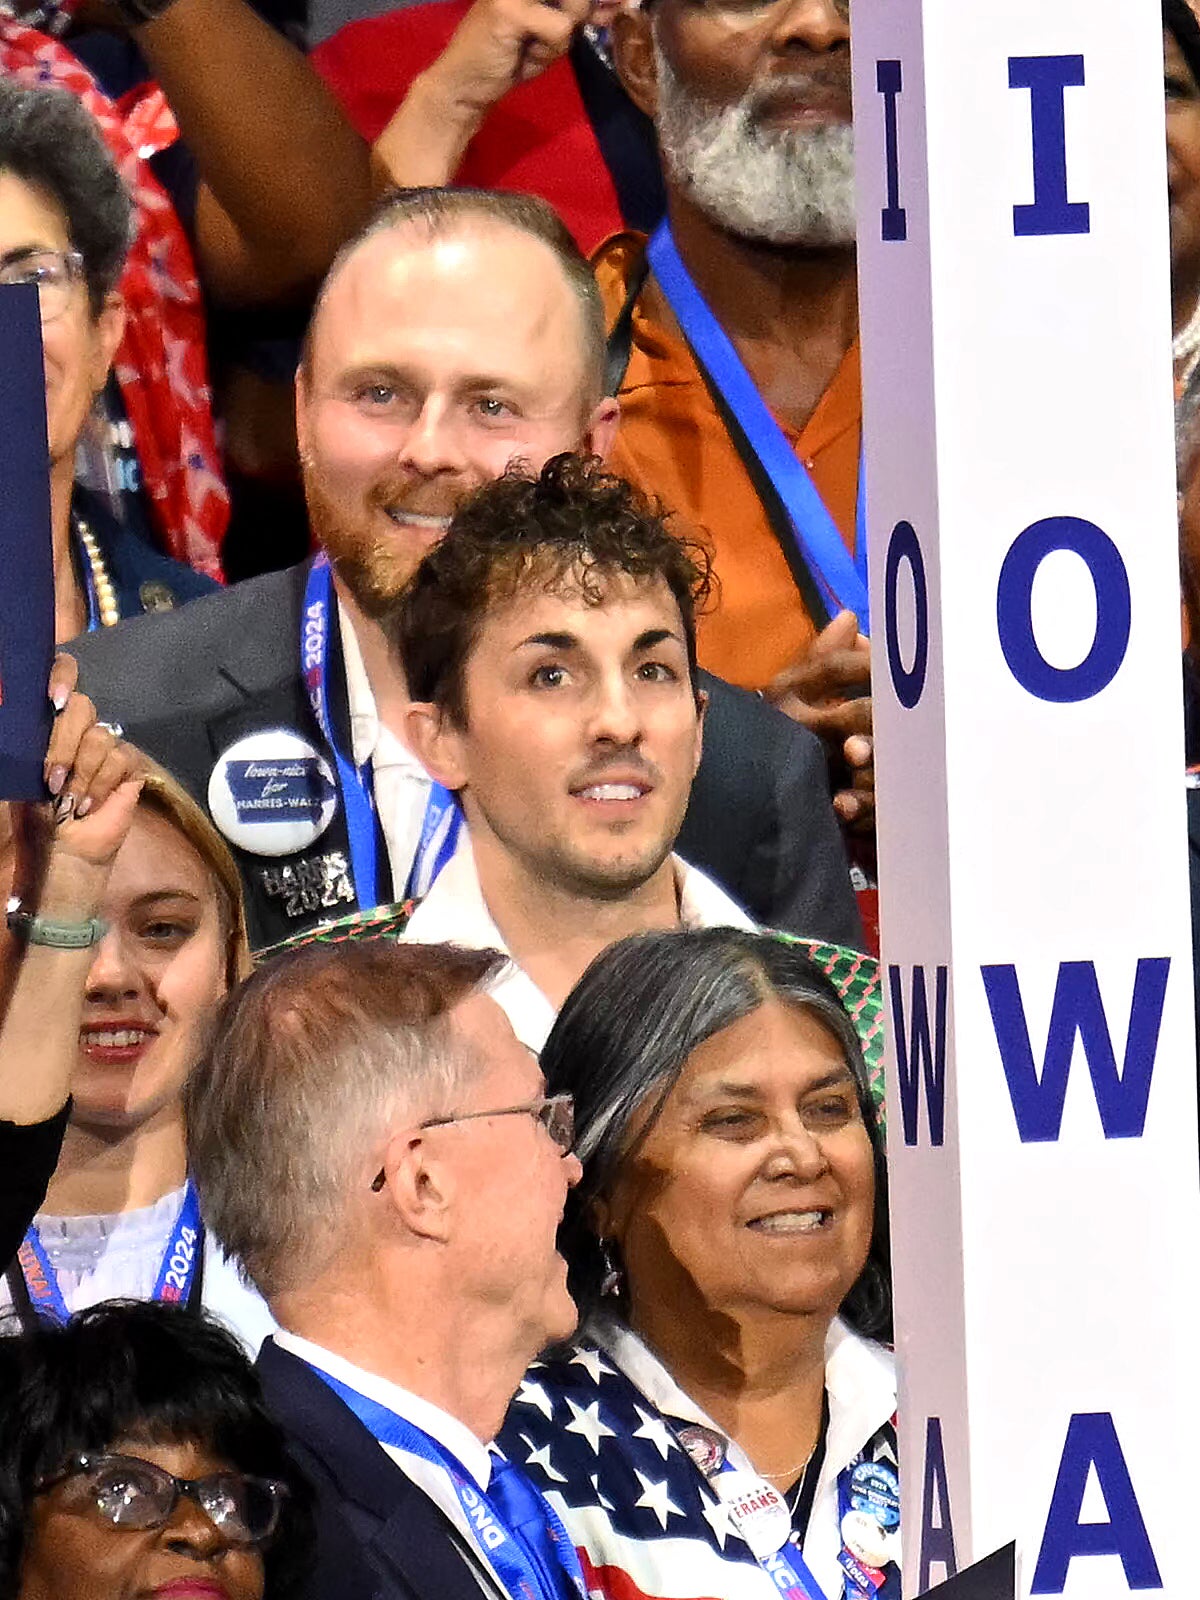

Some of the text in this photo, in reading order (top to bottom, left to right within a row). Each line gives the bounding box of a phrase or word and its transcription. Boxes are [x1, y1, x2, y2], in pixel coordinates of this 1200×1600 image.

[304, 600, 325, 669] 2024
[980, 54, 1171, 1595] IOWA
[166, 1226, 198, 1289] 2024
[461, 1487, 506, 1550] DNC
[733, 1491, 778, 1518] ERANS
[763, 1552, 796, 1590] NC
